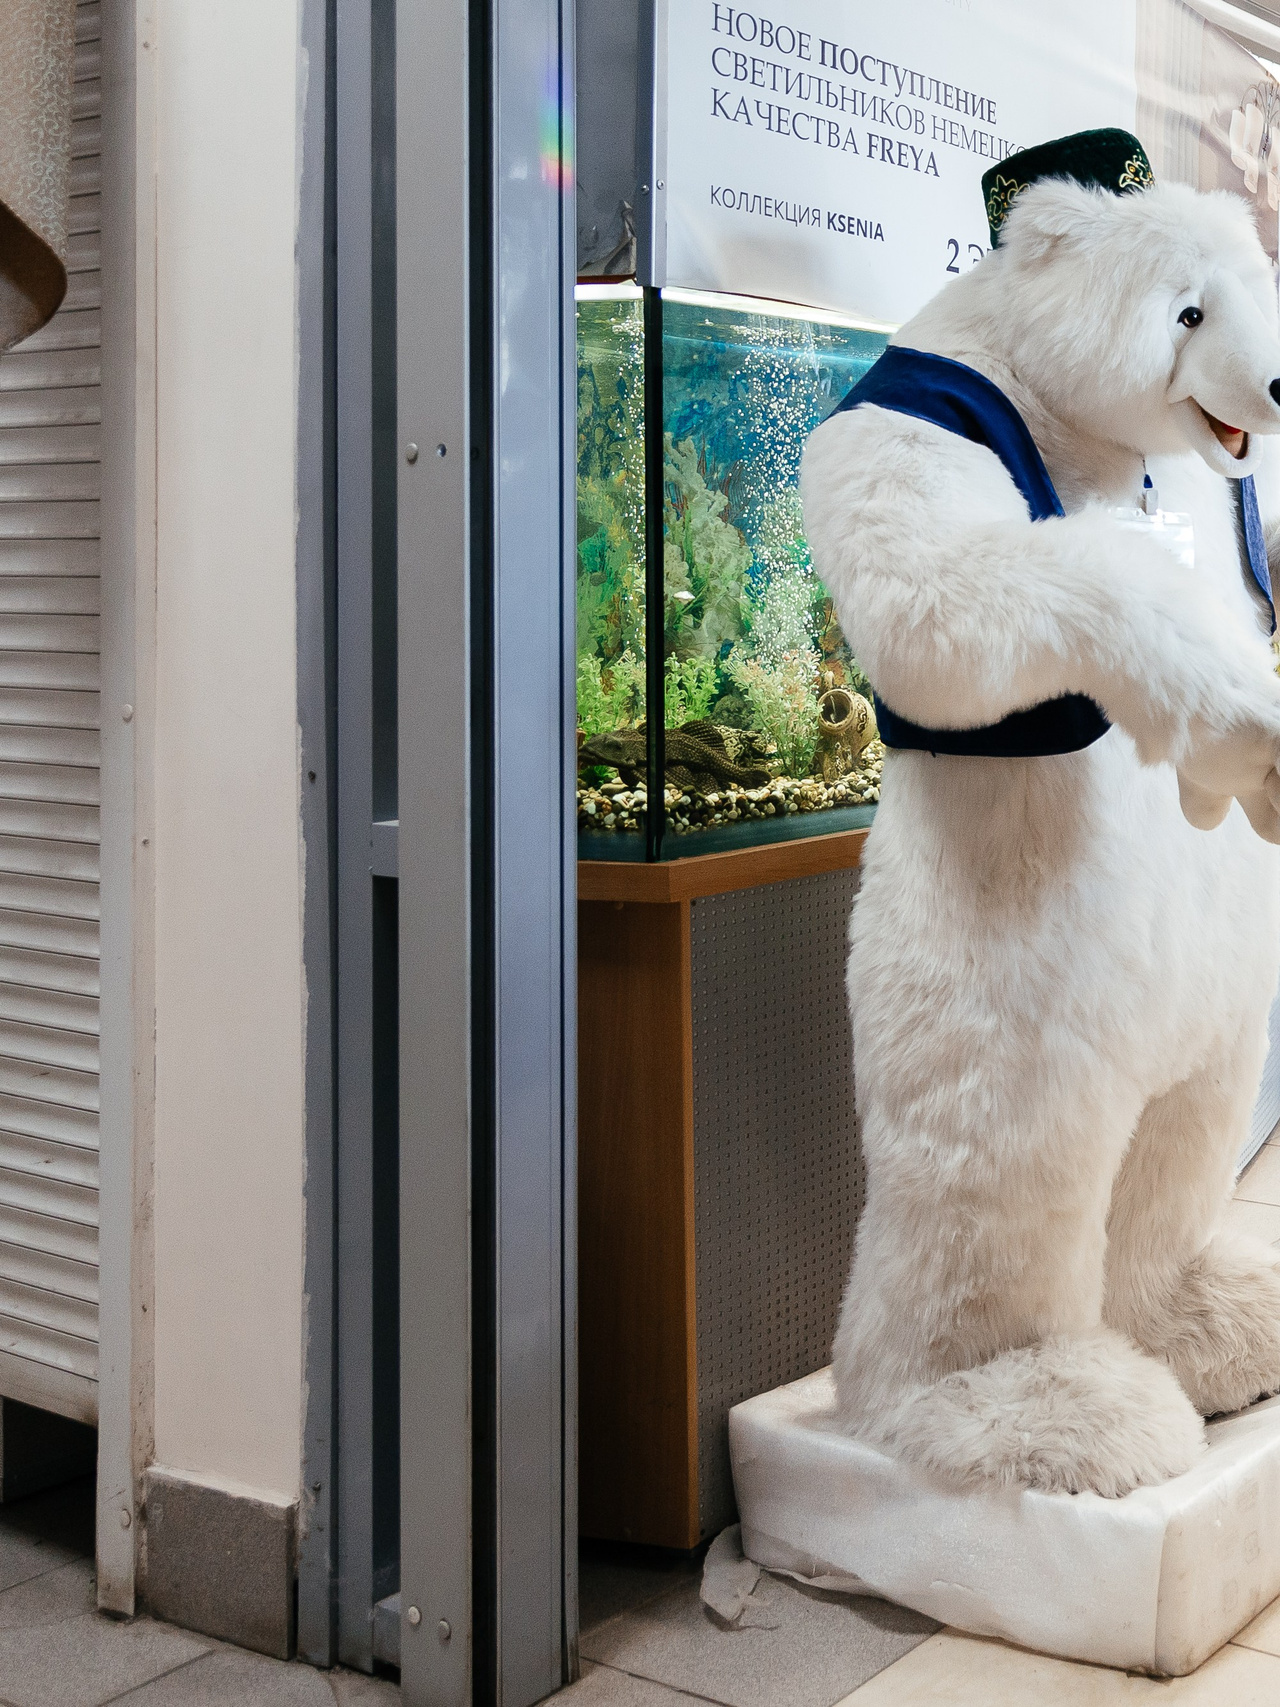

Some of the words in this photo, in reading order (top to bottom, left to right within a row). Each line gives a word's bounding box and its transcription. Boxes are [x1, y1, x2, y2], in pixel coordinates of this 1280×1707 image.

[710, 2, 813, 61] НОВОЕ
[818, 37, 999, 126] ПОСТУПЛЕНИЕ
[710, 47, 926, 136] СВЕТИЛЬНИКОВ
[930, 115, 1026, 162] НЕМЕЦК
[709, 88, 859, 156] КАЧЕСТВА
[866, 132, 941, 179] FREYA
[709, 184, 822, 230] КОЛЛЕКЦИЯ
[826, 211, 886, 242] KSENIA
[946, 238, 960, 274] 2
